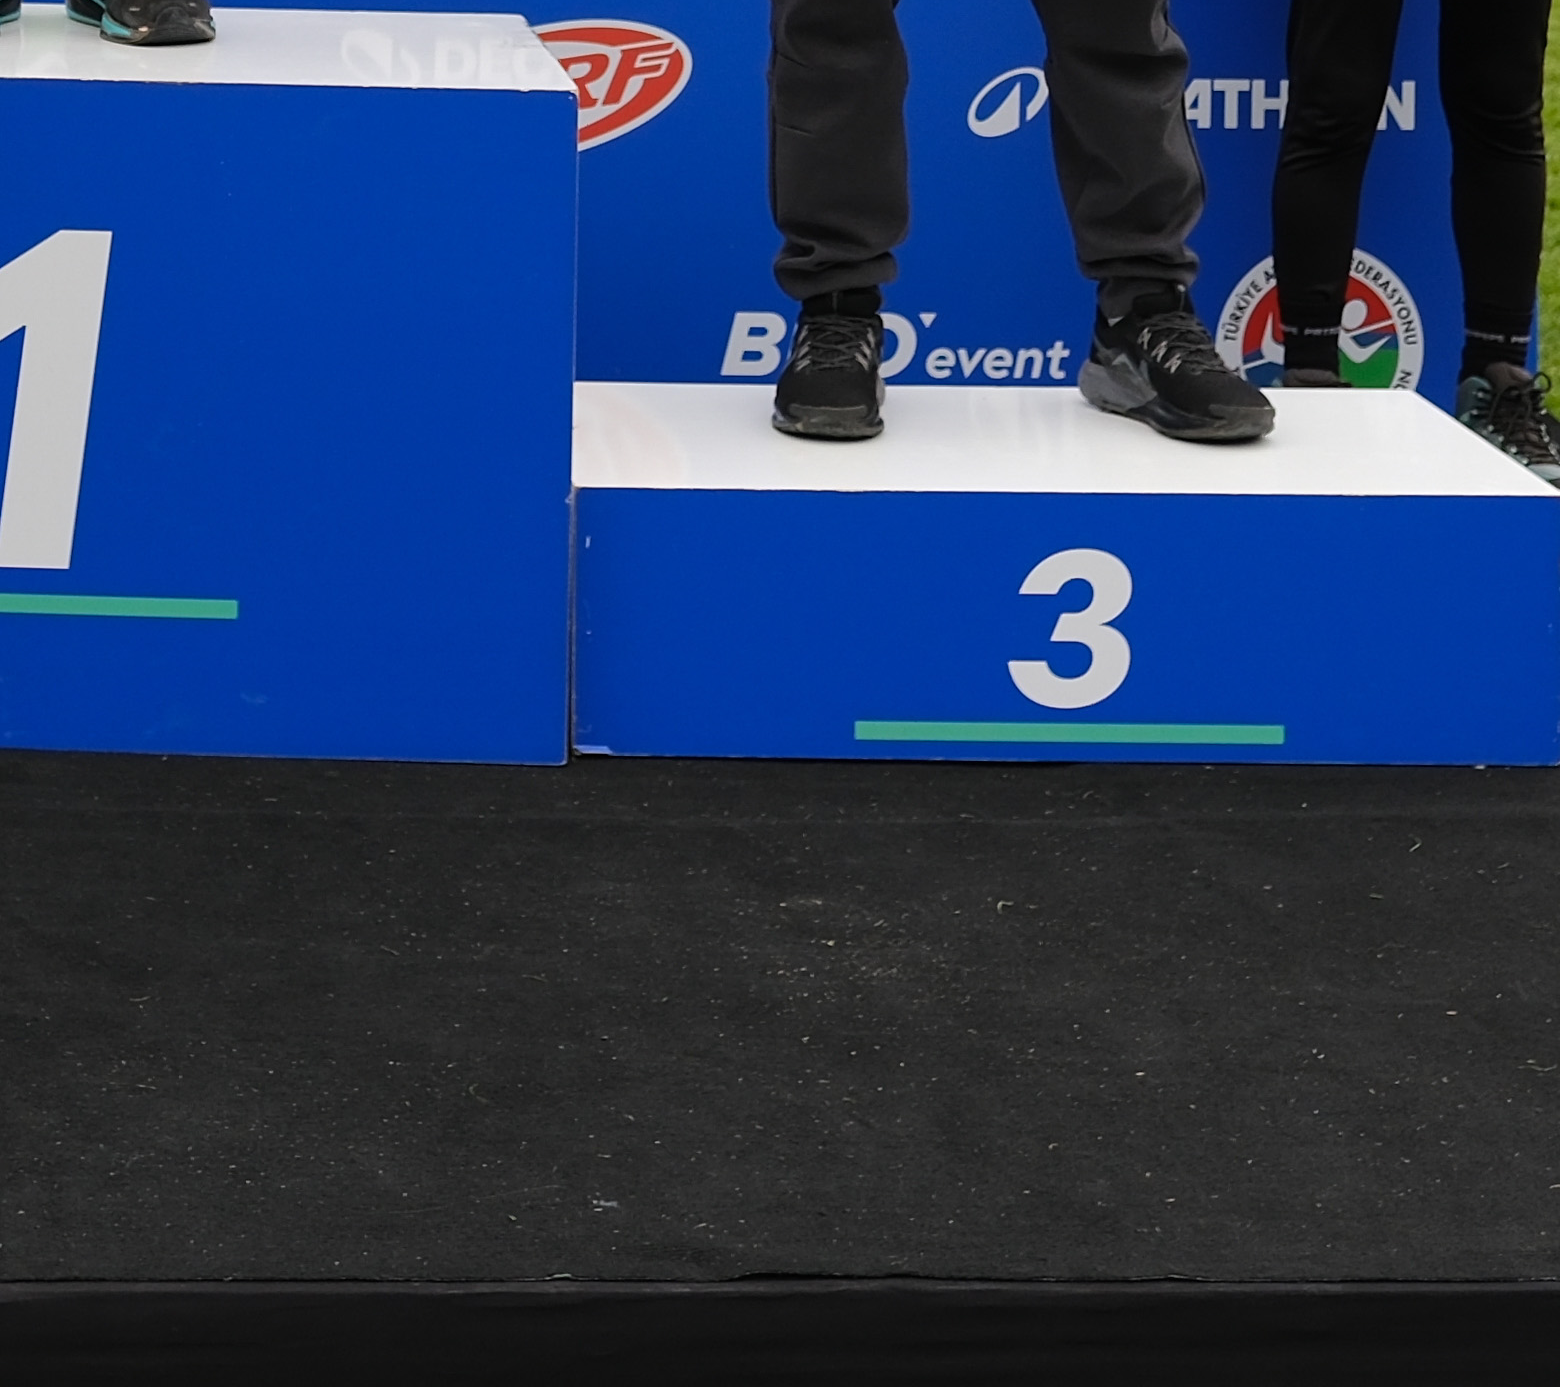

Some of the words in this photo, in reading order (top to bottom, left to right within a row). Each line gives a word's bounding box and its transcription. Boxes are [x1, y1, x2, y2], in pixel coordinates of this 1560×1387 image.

[720, 311, 918, 379] BO
[925, 340, 1071, 380] event
[1350, 257, 1419, 347] DERASYONU
[1007, 548, 1133, 709] 3
